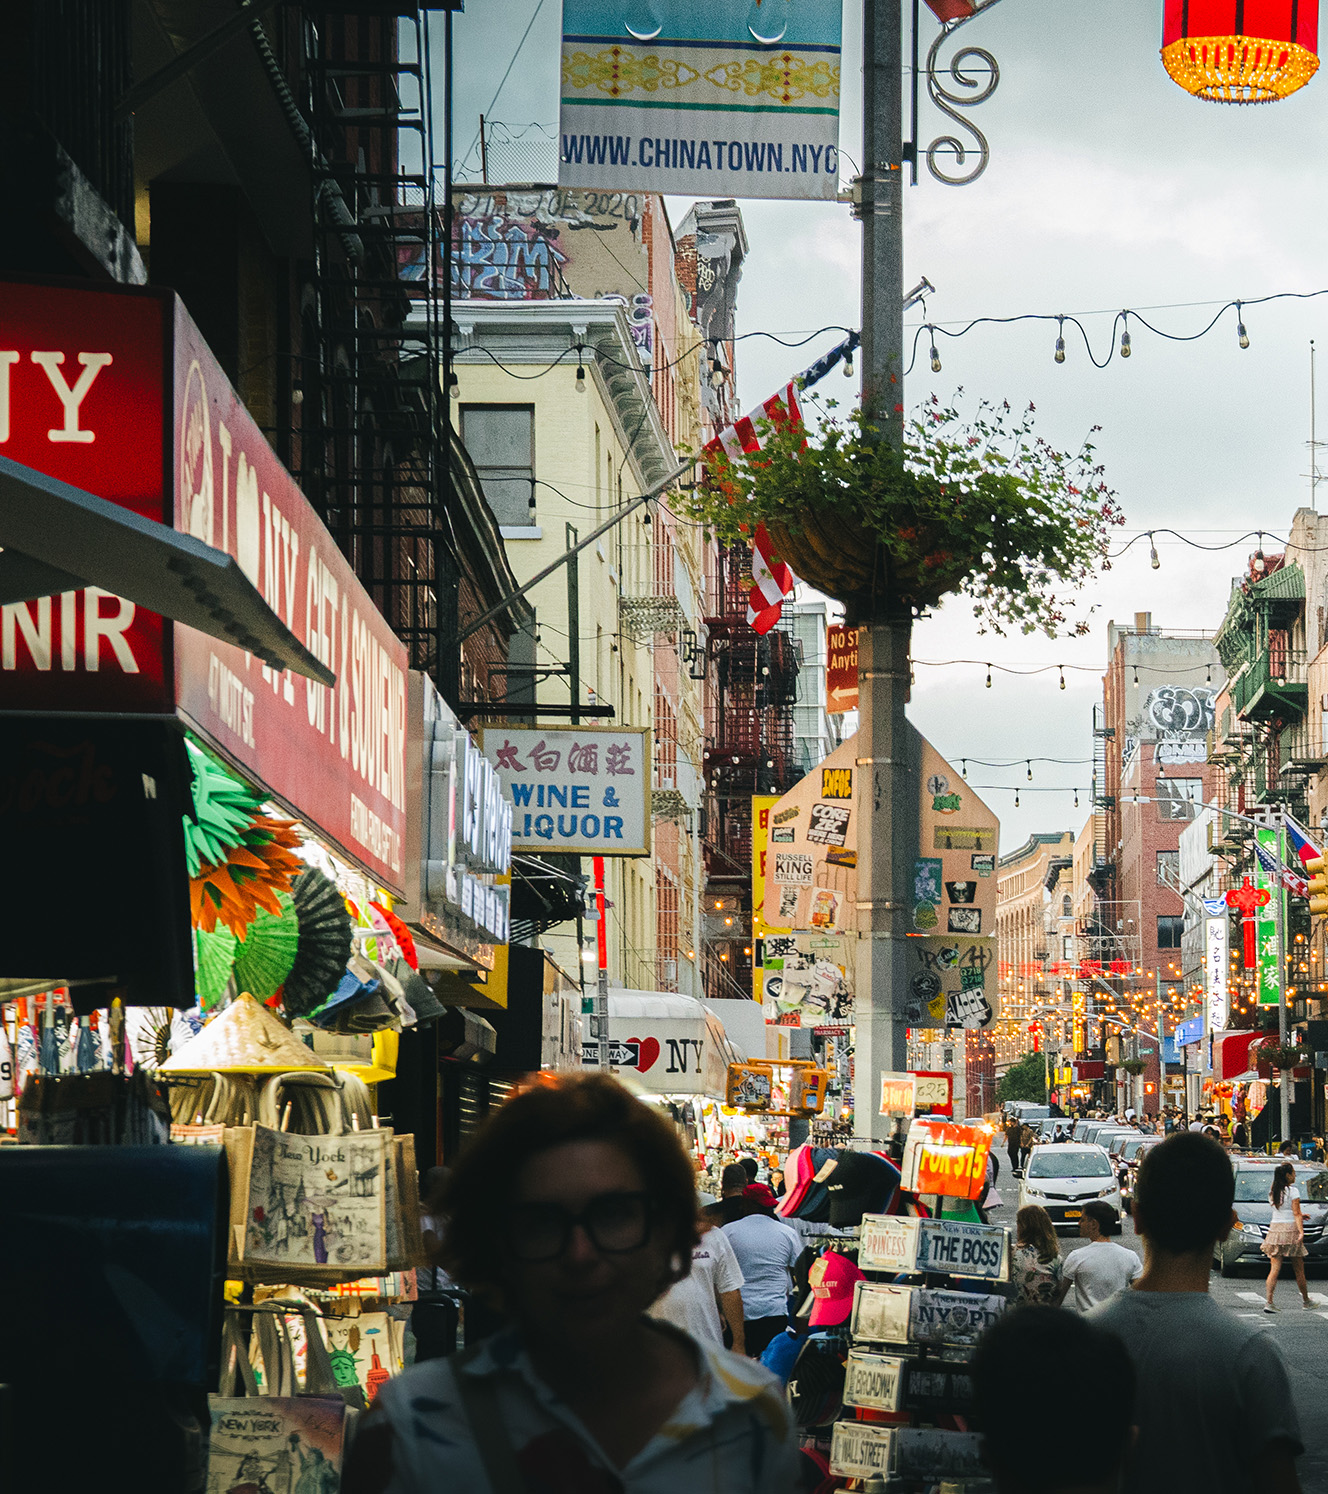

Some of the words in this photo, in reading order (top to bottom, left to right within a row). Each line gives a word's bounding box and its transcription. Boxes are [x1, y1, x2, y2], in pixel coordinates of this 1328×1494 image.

[562, 134, 837, 174] WWW.CHINATOWN.NYC
[585, 192, 638, 221] 2020
[831, 632, 845, 650] NO
[831, 650, 858, 671] Anyti
[306, 545, 338, 745] GIFT
[350, 607, 406, 814] SOUVENIR
[494, 739, 636, 777] 太白酒莊
[511, 783, 590, 809] WINE
[603, 785, 620, 808] &
[775, 853, 813, 862] RUSSELL
[775, 861, 813, 875] KING
[774, 873, 795, 881] STILL
[796, 873, 813, 882] LIFE
[581, 1050, 598, 1059] ONE
[608, 1050, 628, 1060] WAY
[666, 1039, 704, 1073] NY
[962, 1226, 981, 1236] YORK
[866, 1233, 907, 1257] PRINCESS
[932, 1234, 960, 1263] THE
[961, 1238, 1000, 1268] BOSS
[918, 1304, 951, 1325] NY
[969, 1309, 1000, 1327] PD
[855, 1369, 897, 1400] BROADWAY
[220, 1418, 248, 1431] NEW
[249, 1418, 282, 1433] YORK
[841, 1437, 860, 1465] WALL
[859, 1440, 887, 1468] STREET
